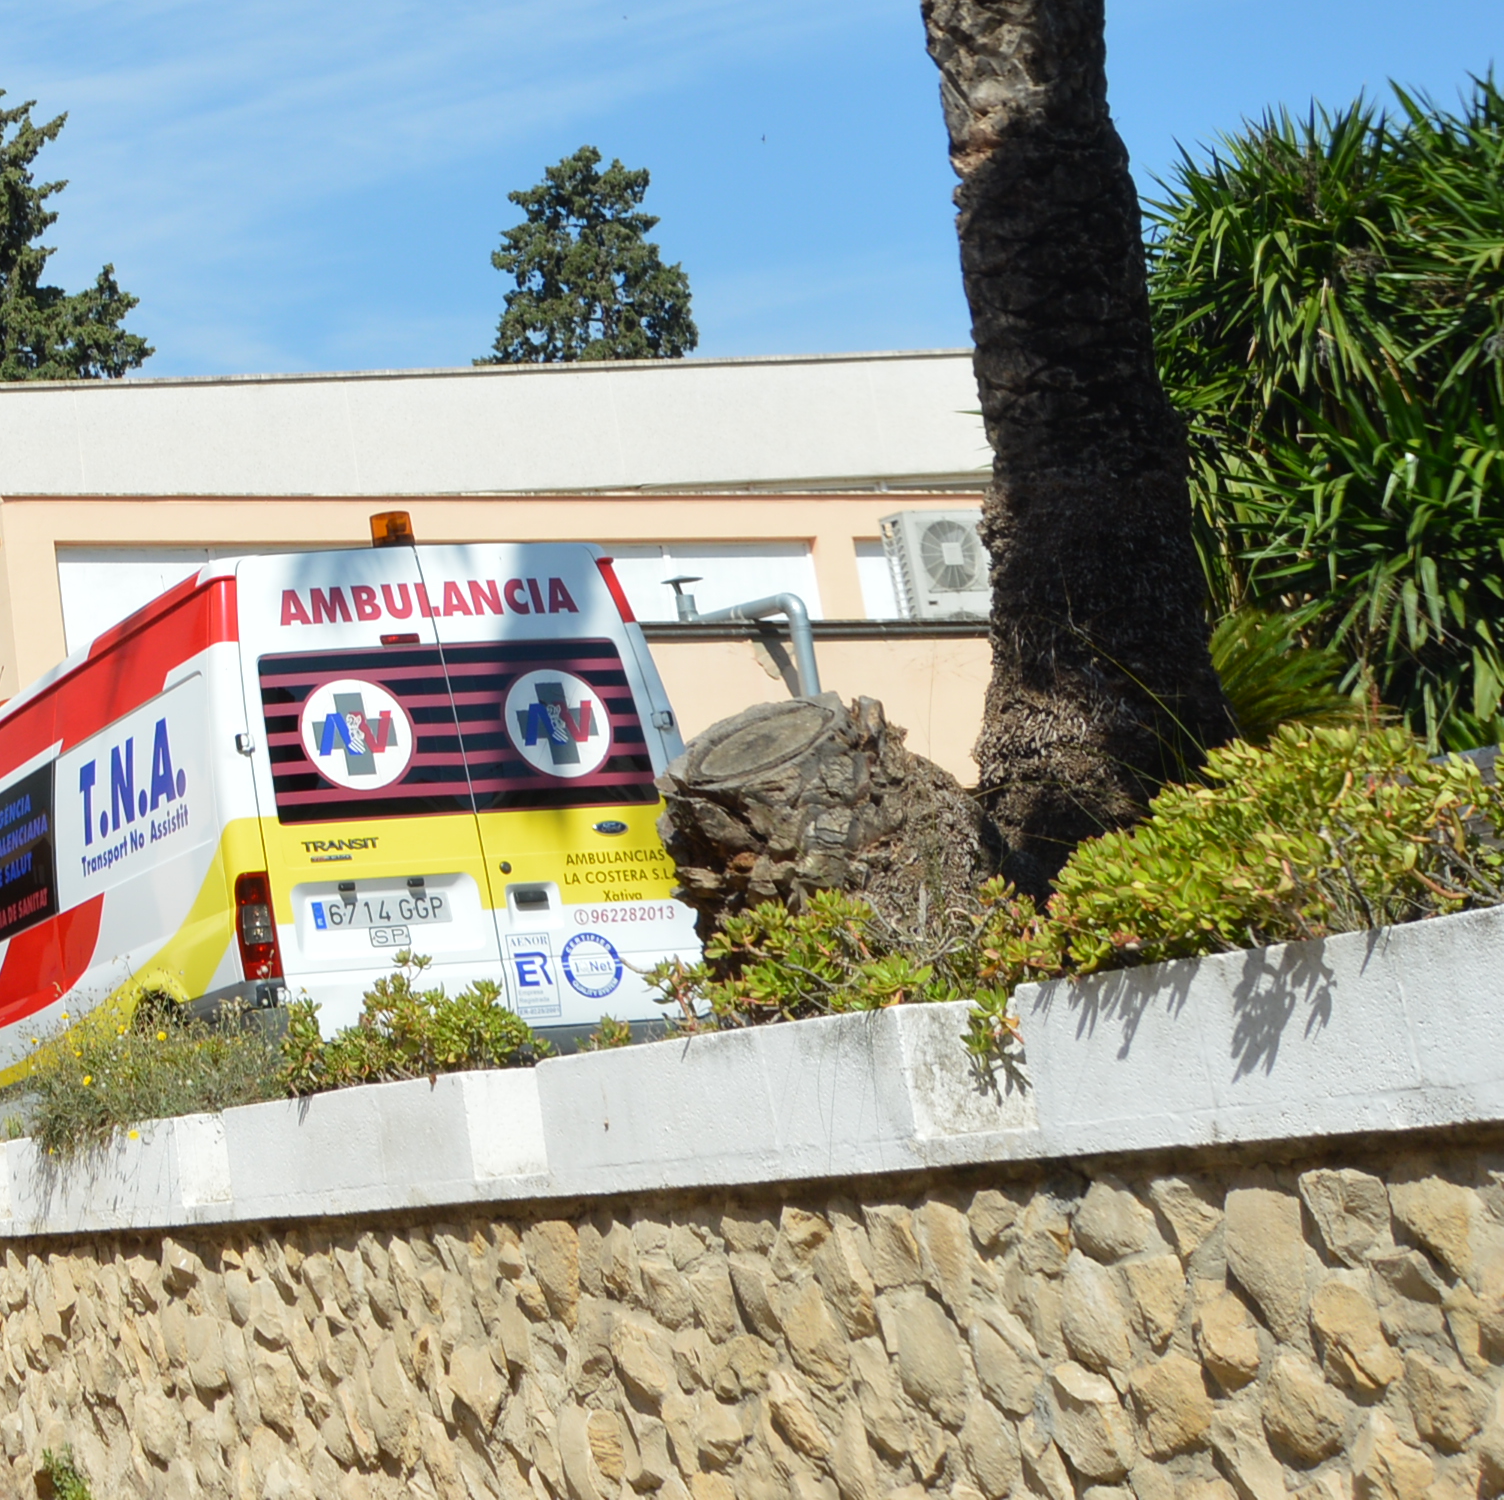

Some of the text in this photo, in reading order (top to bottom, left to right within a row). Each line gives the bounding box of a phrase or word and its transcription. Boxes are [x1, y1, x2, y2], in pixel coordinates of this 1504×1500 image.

[280, 577, 579, 626] AMBULANCIA
[79, 717, 187, 847] T.N.A.
[81, 803, 189, 878] Transport No Assistit
[301, 837, 379, 853] TRANSIT
[4, 851, 33, 884] SALUT
[565, 848, 666, 866] AMBULANCIAS
[563, 872, 582, 886] LA
[585, 868, 649, 884] COSTERA
[7, 907, 16, 925] DE
[17, 887, 48, 918] SANITAT
[328, 896, 443, 926] 6714 GGP
[591, 905, 675, 924] 962282013
[374, 928, 404, 944] SP
[510, 935, 549, 947] AENOR
